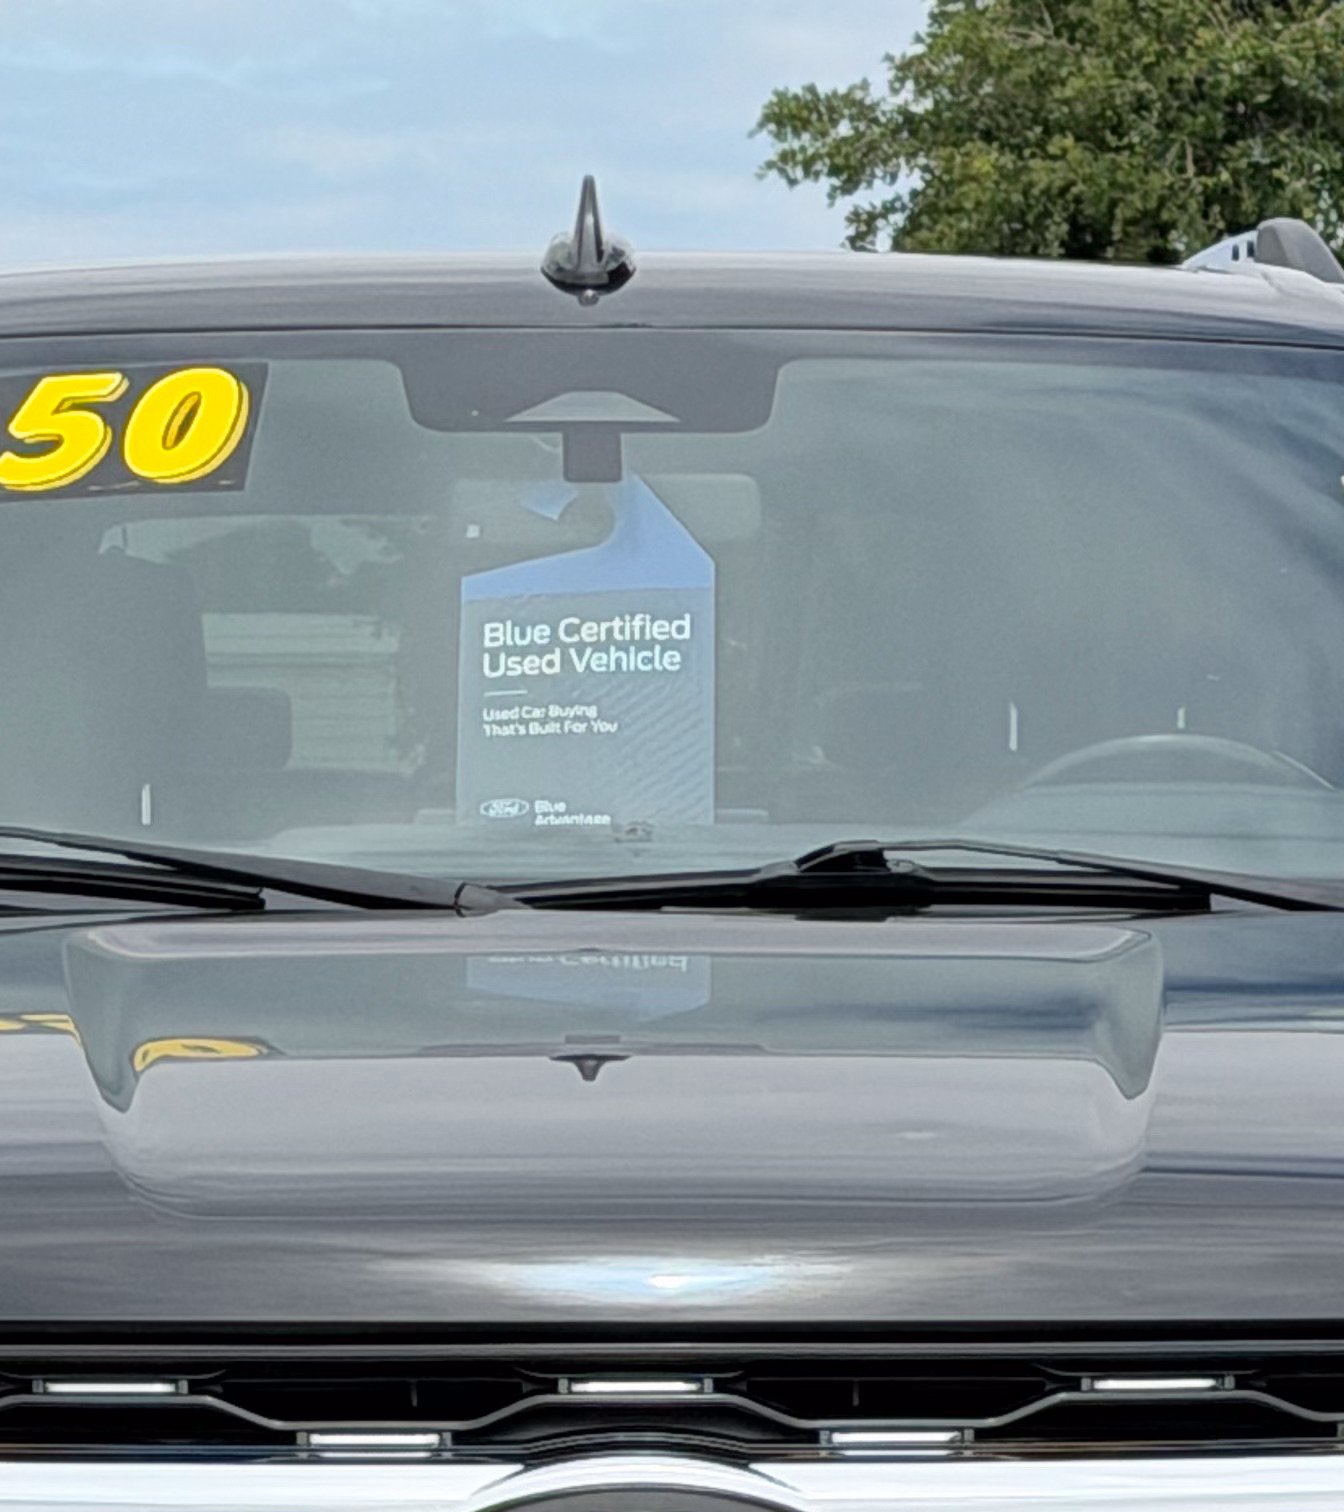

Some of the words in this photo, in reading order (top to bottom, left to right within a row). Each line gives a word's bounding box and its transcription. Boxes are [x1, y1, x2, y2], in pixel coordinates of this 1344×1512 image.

[482, 620, 552, 648] Blue
[557, 613, 692, 643] Certified
[482, 647, 561, 679] Used
[568, 644, 682, 672] Vehicle
[482, 707, 519, 721] Used
[521, 706, 546, 719] Car
[548, 704, 597, 719] Buying
[482, 722, 526, 737] That's
[528, 721, 562, 735] Built
[563, 720, 588, 734] For
[590, 719, 618, 733] You
